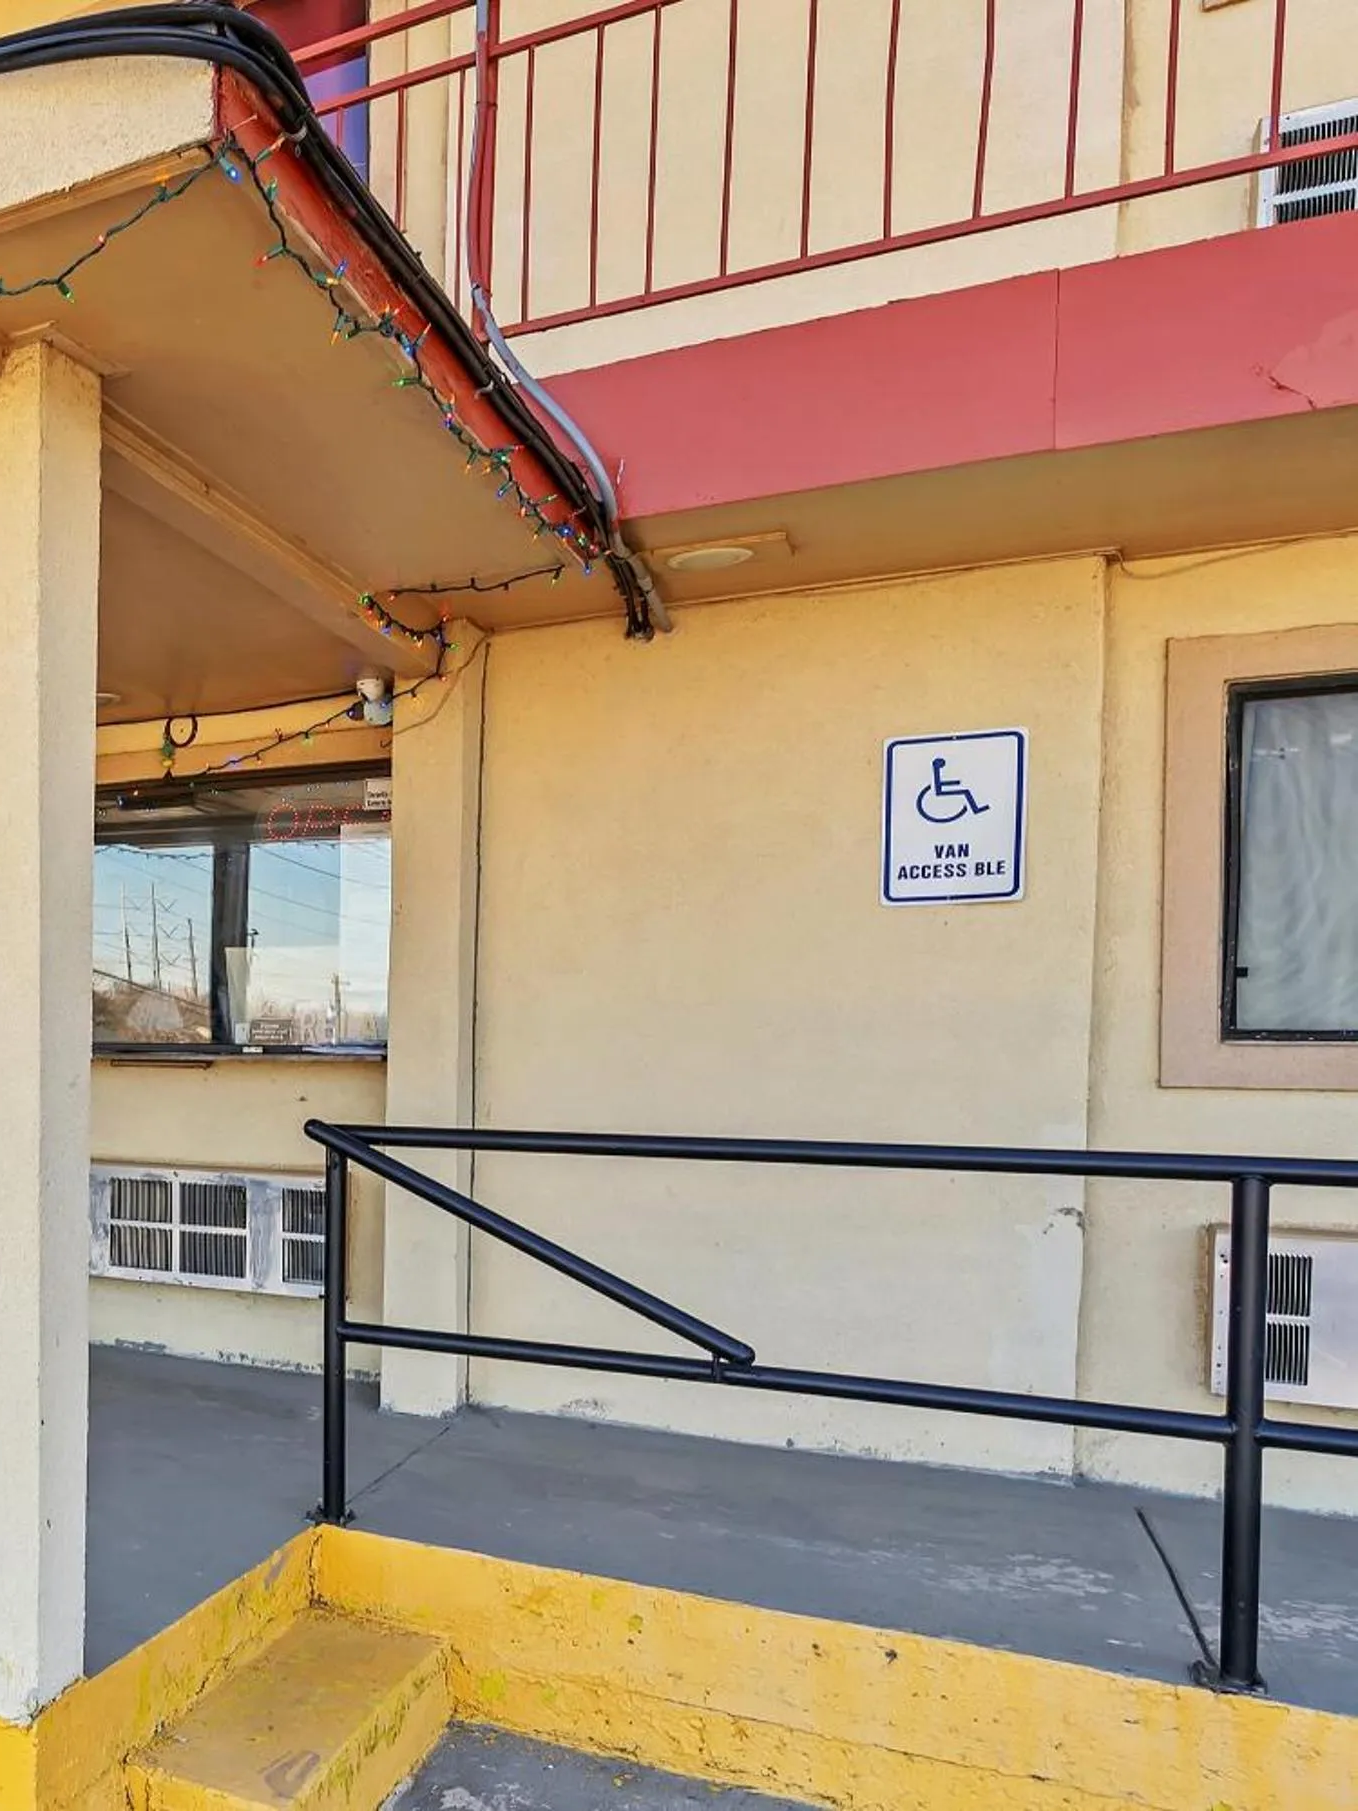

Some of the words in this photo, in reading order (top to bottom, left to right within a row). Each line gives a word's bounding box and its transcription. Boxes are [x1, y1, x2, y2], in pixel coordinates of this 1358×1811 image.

[934, 843, 970, 859] VAN
[898, 862, 967, 880] ACCESS
[974, 860, 1006, 876] BLE
